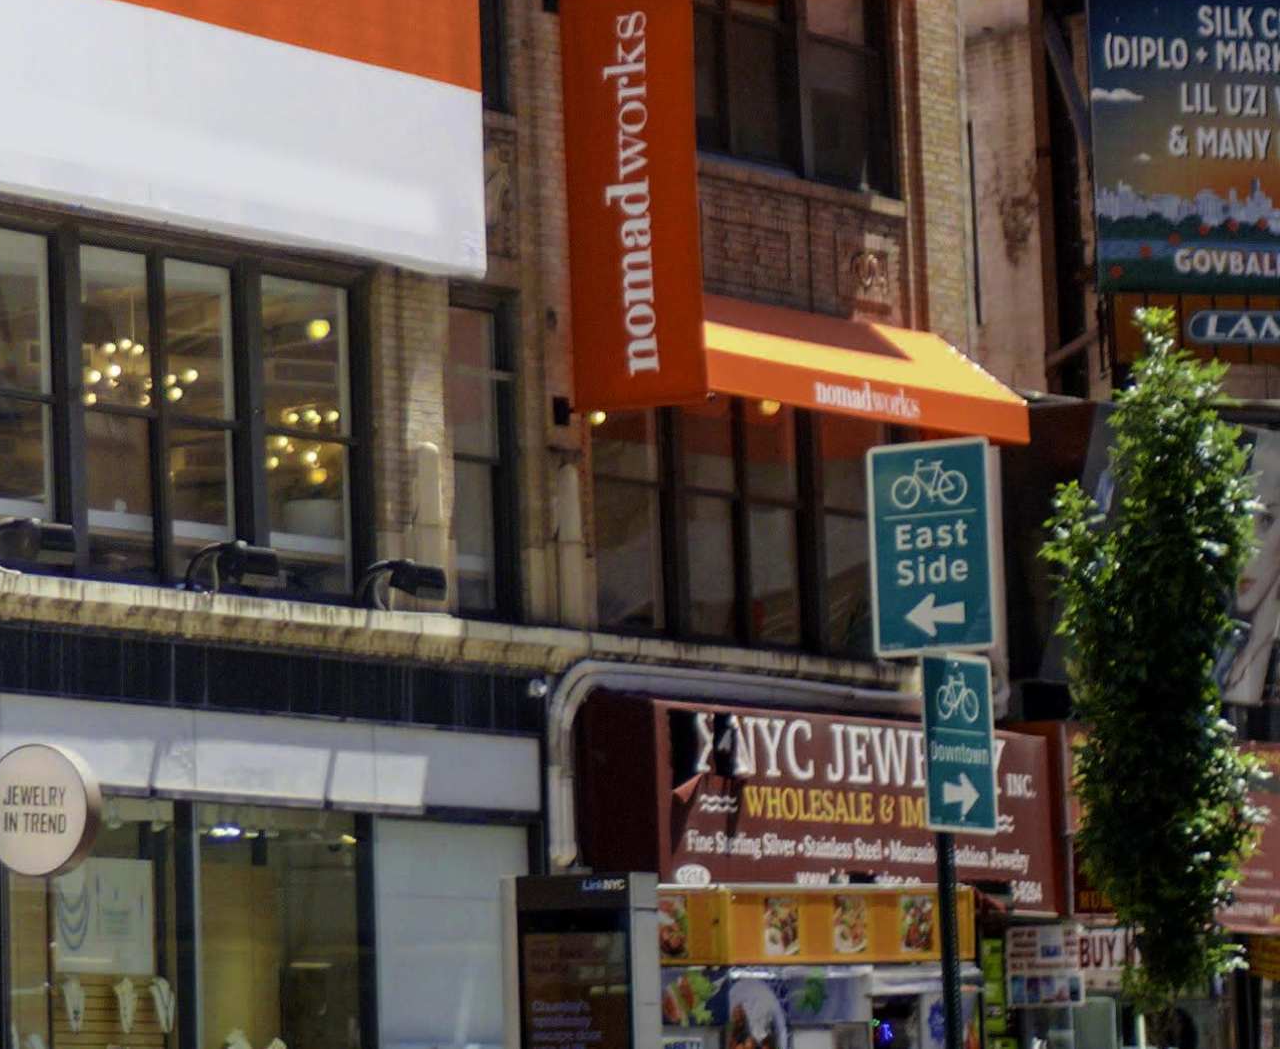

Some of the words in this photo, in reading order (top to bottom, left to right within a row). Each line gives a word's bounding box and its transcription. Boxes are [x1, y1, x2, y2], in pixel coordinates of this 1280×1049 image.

[1197, 4, 1254, 38] SILK
[1104, 32, 1189, 70] (DIPLO
[1180, 82, 1217, 115] LIL
[1225, 84, 1268, 118] UZI
[1168, 124, 1188, 157] &
[1196, 126, 1272, 161] MANY
[603, 10, 660, 378] nomadworks
[814, 380, 922, 420] nomadworks
[894, 517, 969, 551] East
[896, 555, 970, 586] Side
[931, 740, 990, 765] Downtown
[2, 785, 67, 807] JEWELRY
[743, 785, 875, 824] WHOLESALE
[879, 796, 896, 822] &
[3, 812, 18, 833] IN
[23, 813, 68, 835] TREND
[1079, 936, 1117, 969] BUY
